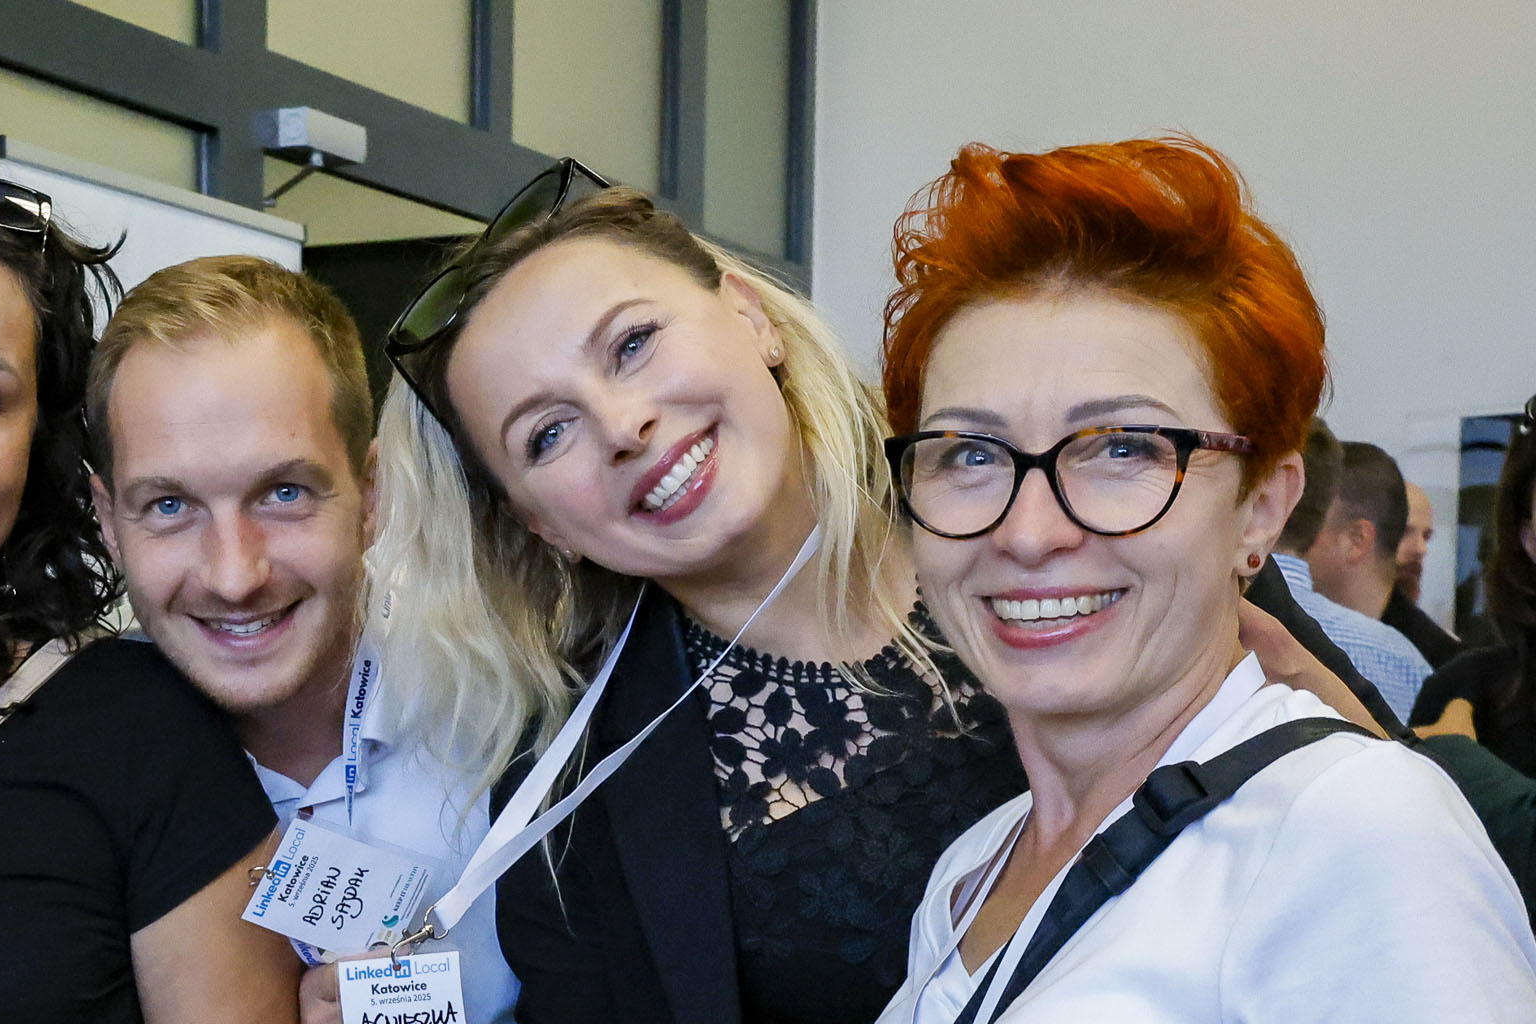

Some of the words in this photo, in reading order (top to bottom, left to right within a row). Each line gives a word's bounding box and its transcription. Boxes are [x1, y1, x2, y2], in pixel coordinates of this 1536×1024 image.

[350, 659, 372, 720] Katowice
[282, 828, 306, 861] Local
[307, 856, 319, 873] 2025
[277, 855, 310, 903] Katowice
[414, 957, 450, 975] Local
[371, 980, 428, 995] Katowice
[379, 995, 412, 1005] września
[413, 993, 432, 1002] 2025
